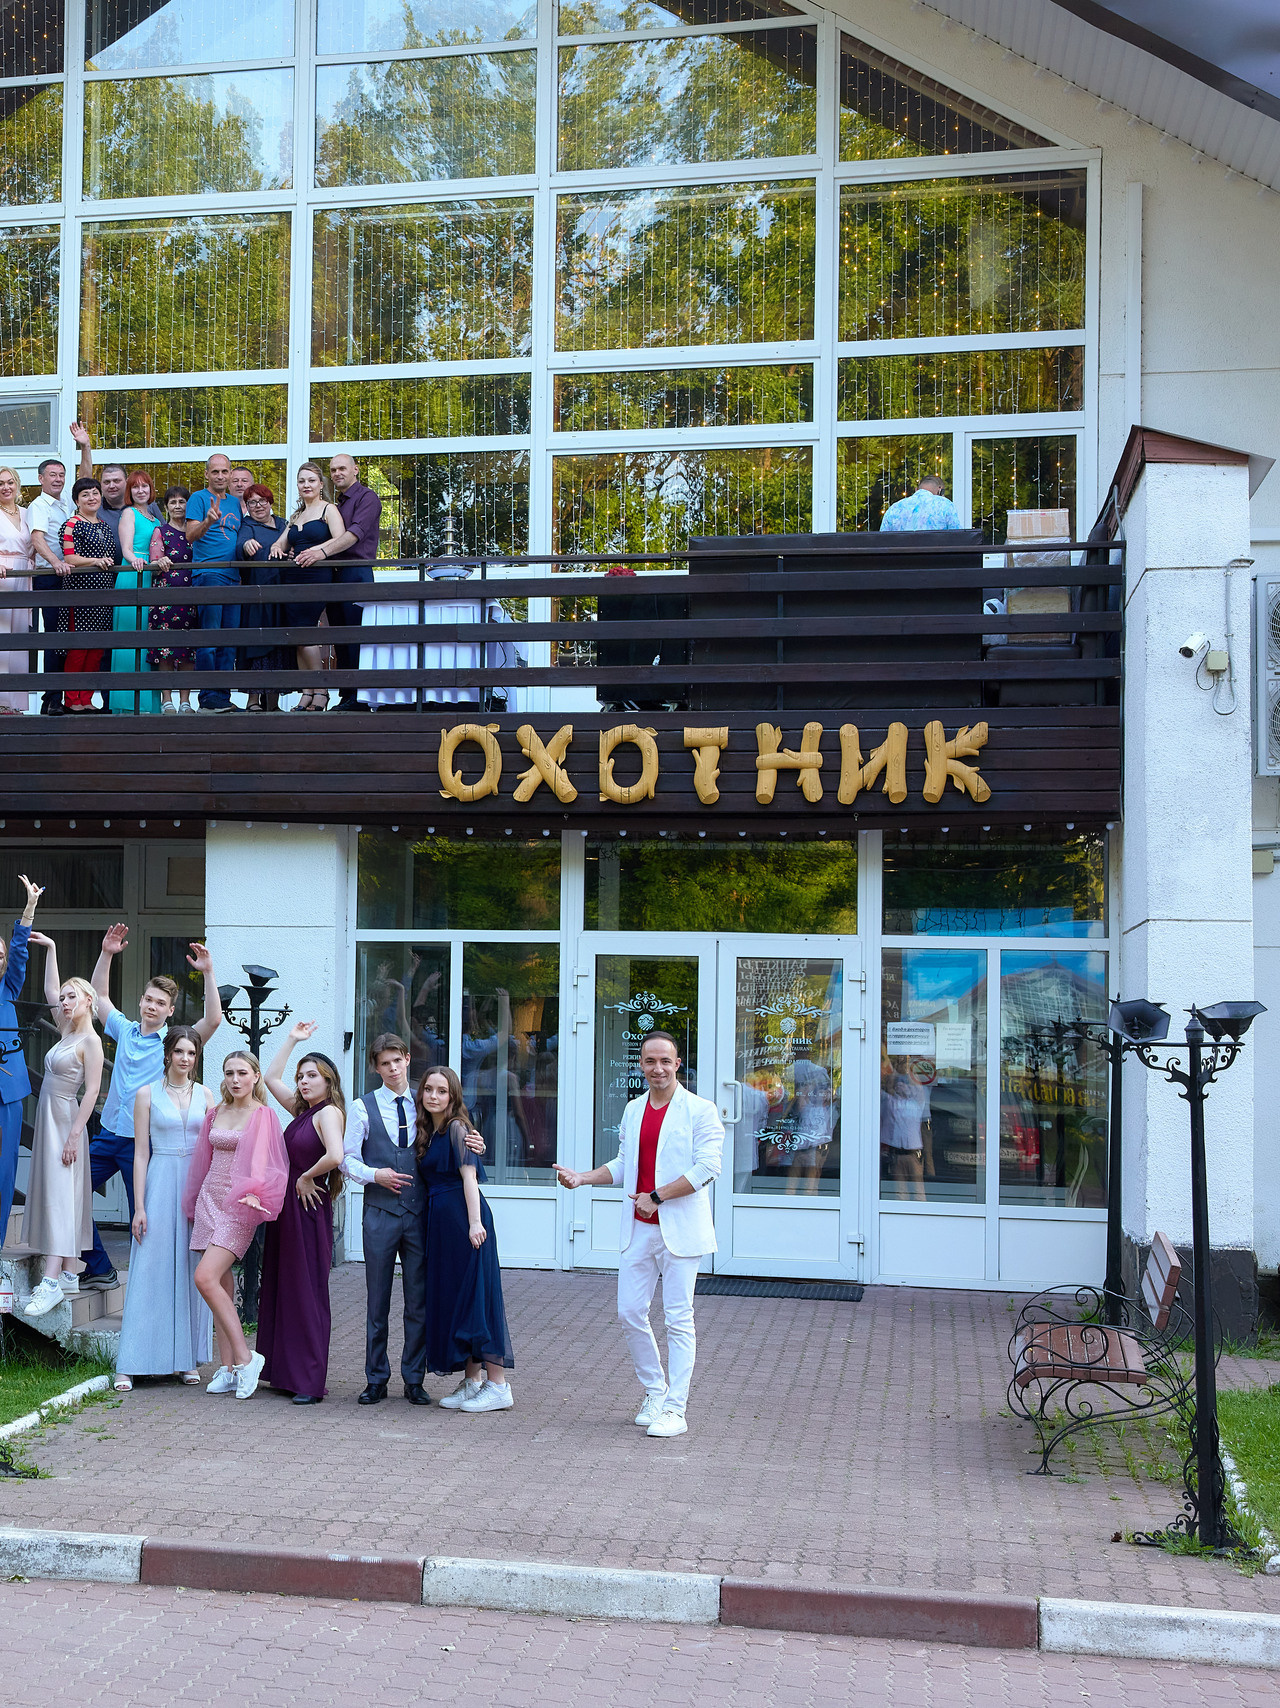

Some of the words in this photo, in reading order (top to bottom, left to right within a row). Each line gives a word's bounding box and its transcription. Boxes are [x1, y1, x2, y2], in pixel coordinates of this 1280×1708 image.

[437, 720, 992, 805] ОХОТНИК
[764, 1034, 813, 1045] Охотник
[616, 1078, 641, 1088] 12.00
